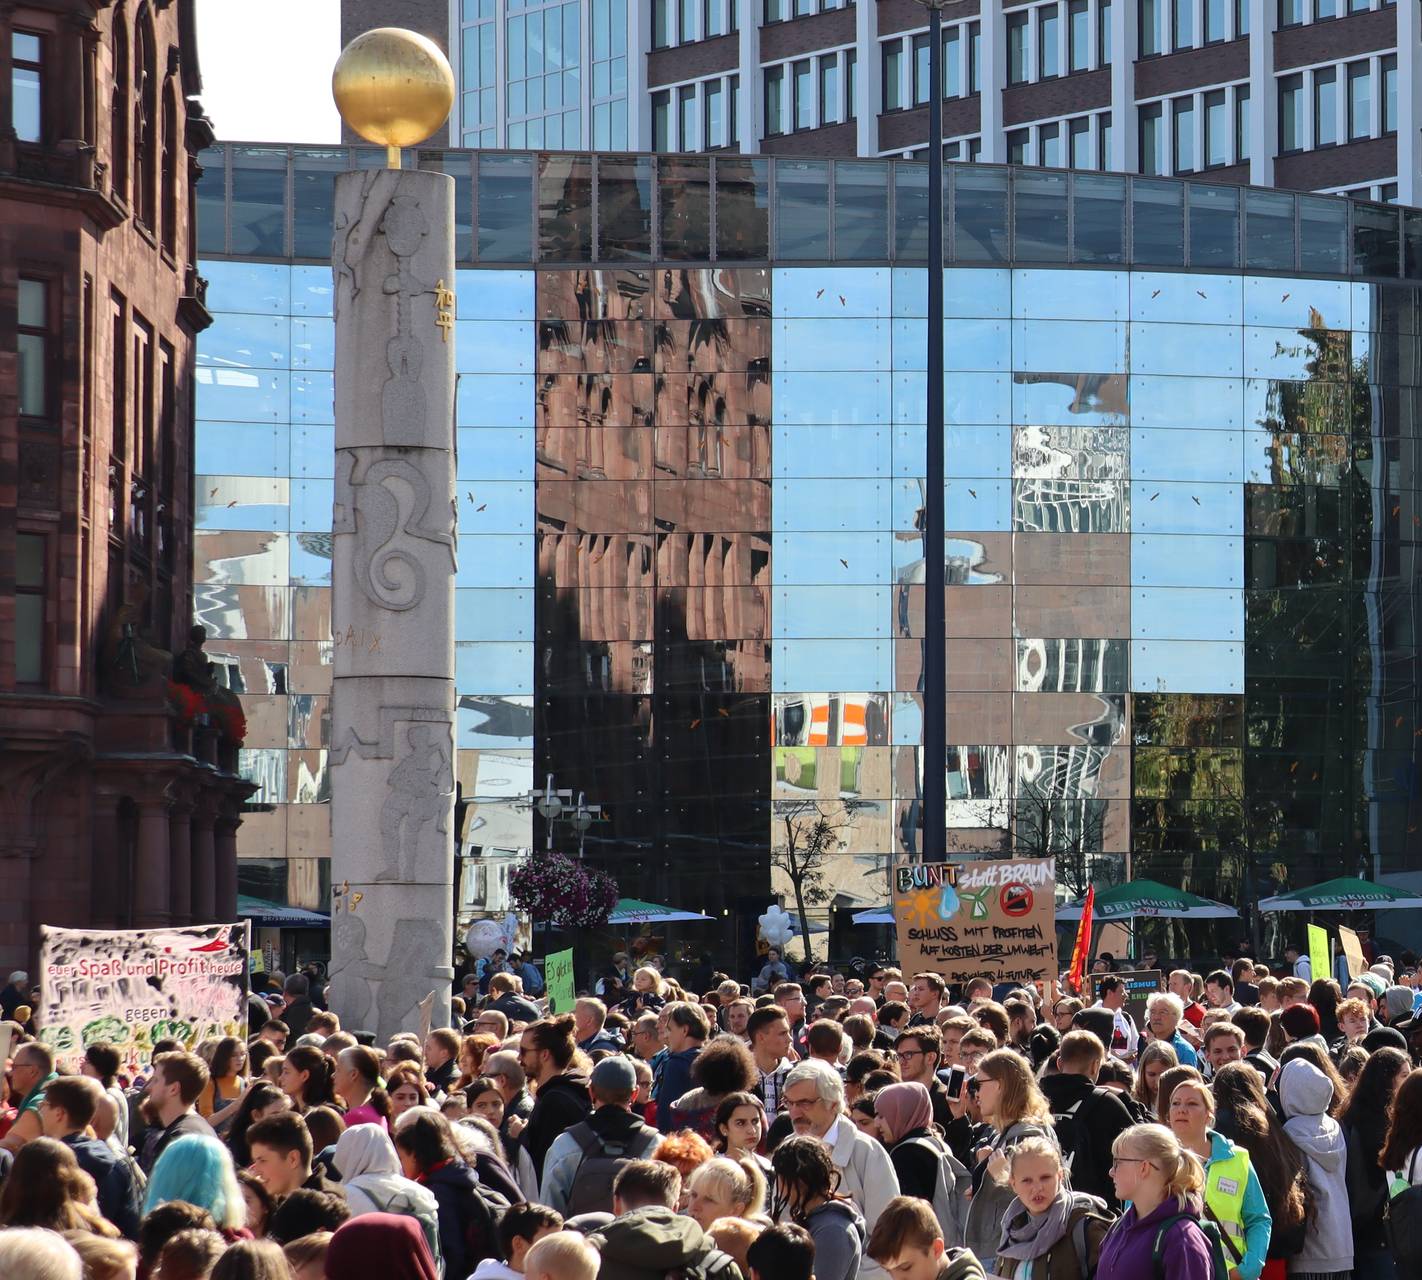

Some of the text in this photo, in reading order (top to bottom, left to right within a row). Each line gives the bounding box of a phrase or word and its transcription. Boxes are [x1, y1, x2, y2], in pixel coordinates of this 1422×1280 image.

[433, 279, 454, 343] 和平
[897, 858, 1055, 893] BUNT statt BRAUN
[908, 924, 1043, 941] SCHLUSS MIT PROFITEN
[920, 943, 1054, 960] AUF KOSTEN DER UMWELT!
[48, 957, 242, 978] euer Spaß und Profit heute
[1004, 968, 1046, 981] FUTURE
[126, 1006, 168, 1023] gegen
